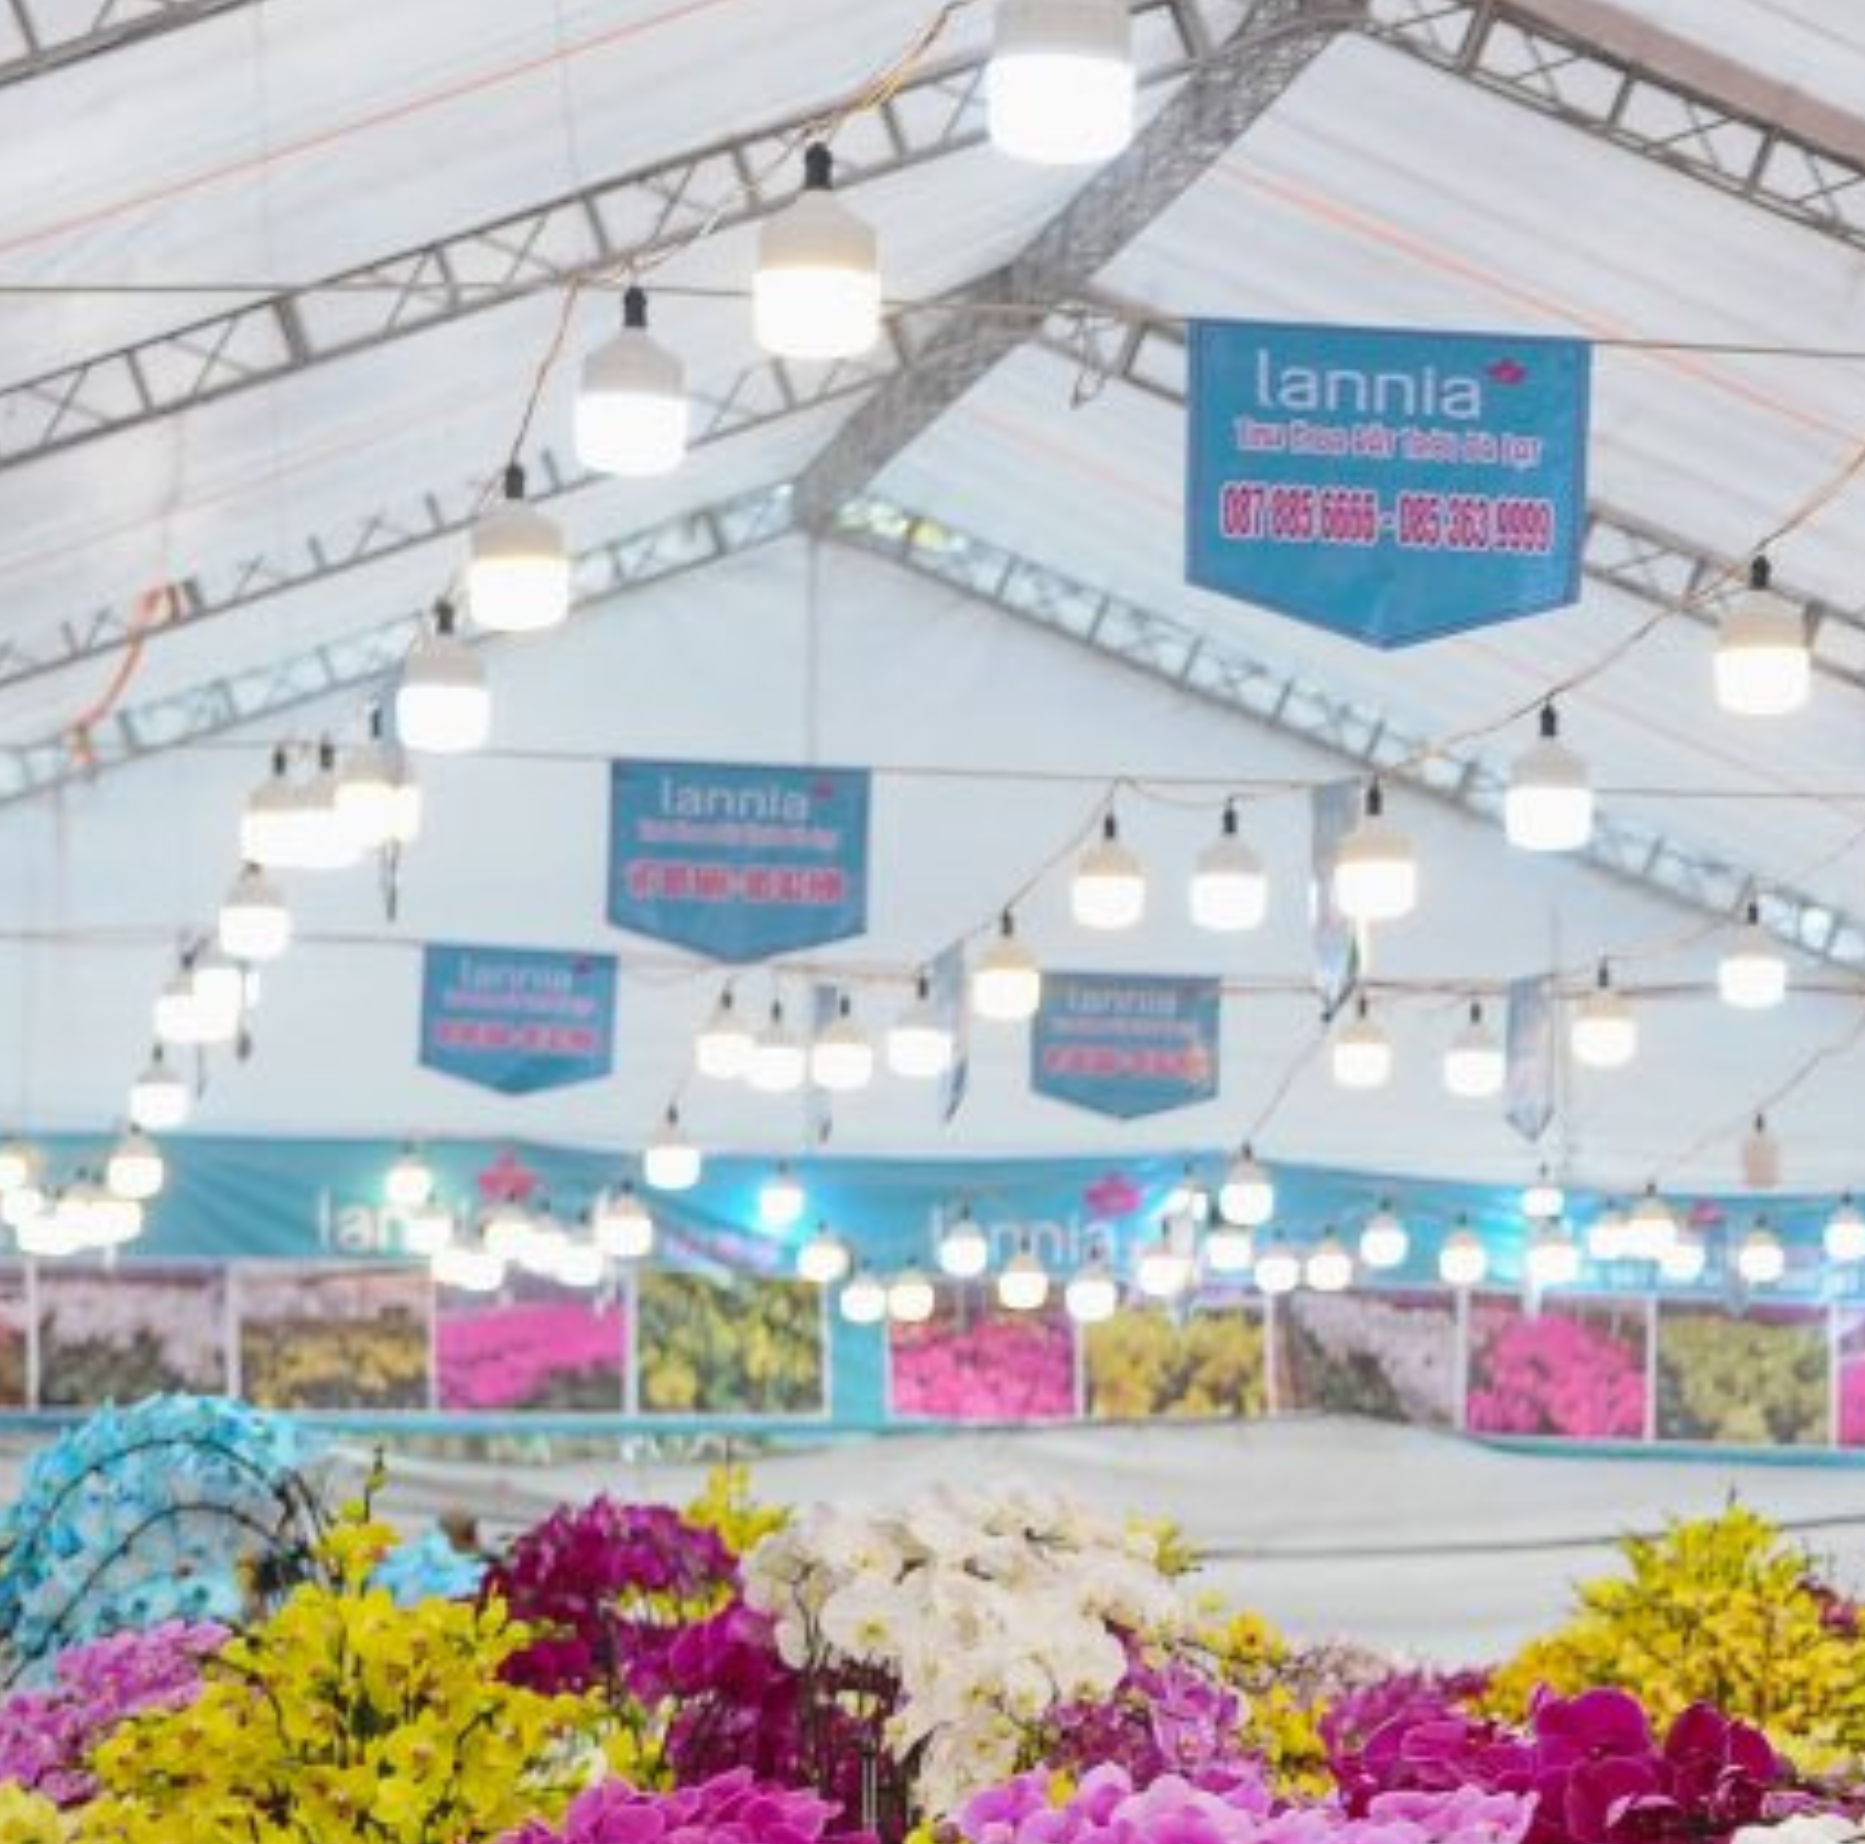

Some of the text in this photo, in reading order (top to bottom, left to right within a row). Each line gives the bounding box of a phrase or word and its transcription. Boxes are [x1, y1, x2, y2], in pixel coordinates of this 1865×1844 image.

[1257, 348, 1483, 418] lannia
[1220, 480, 1268, 540] 087
[1496, 497, 1554, 556] 9999
[660, 770, 809, 821] lannia
